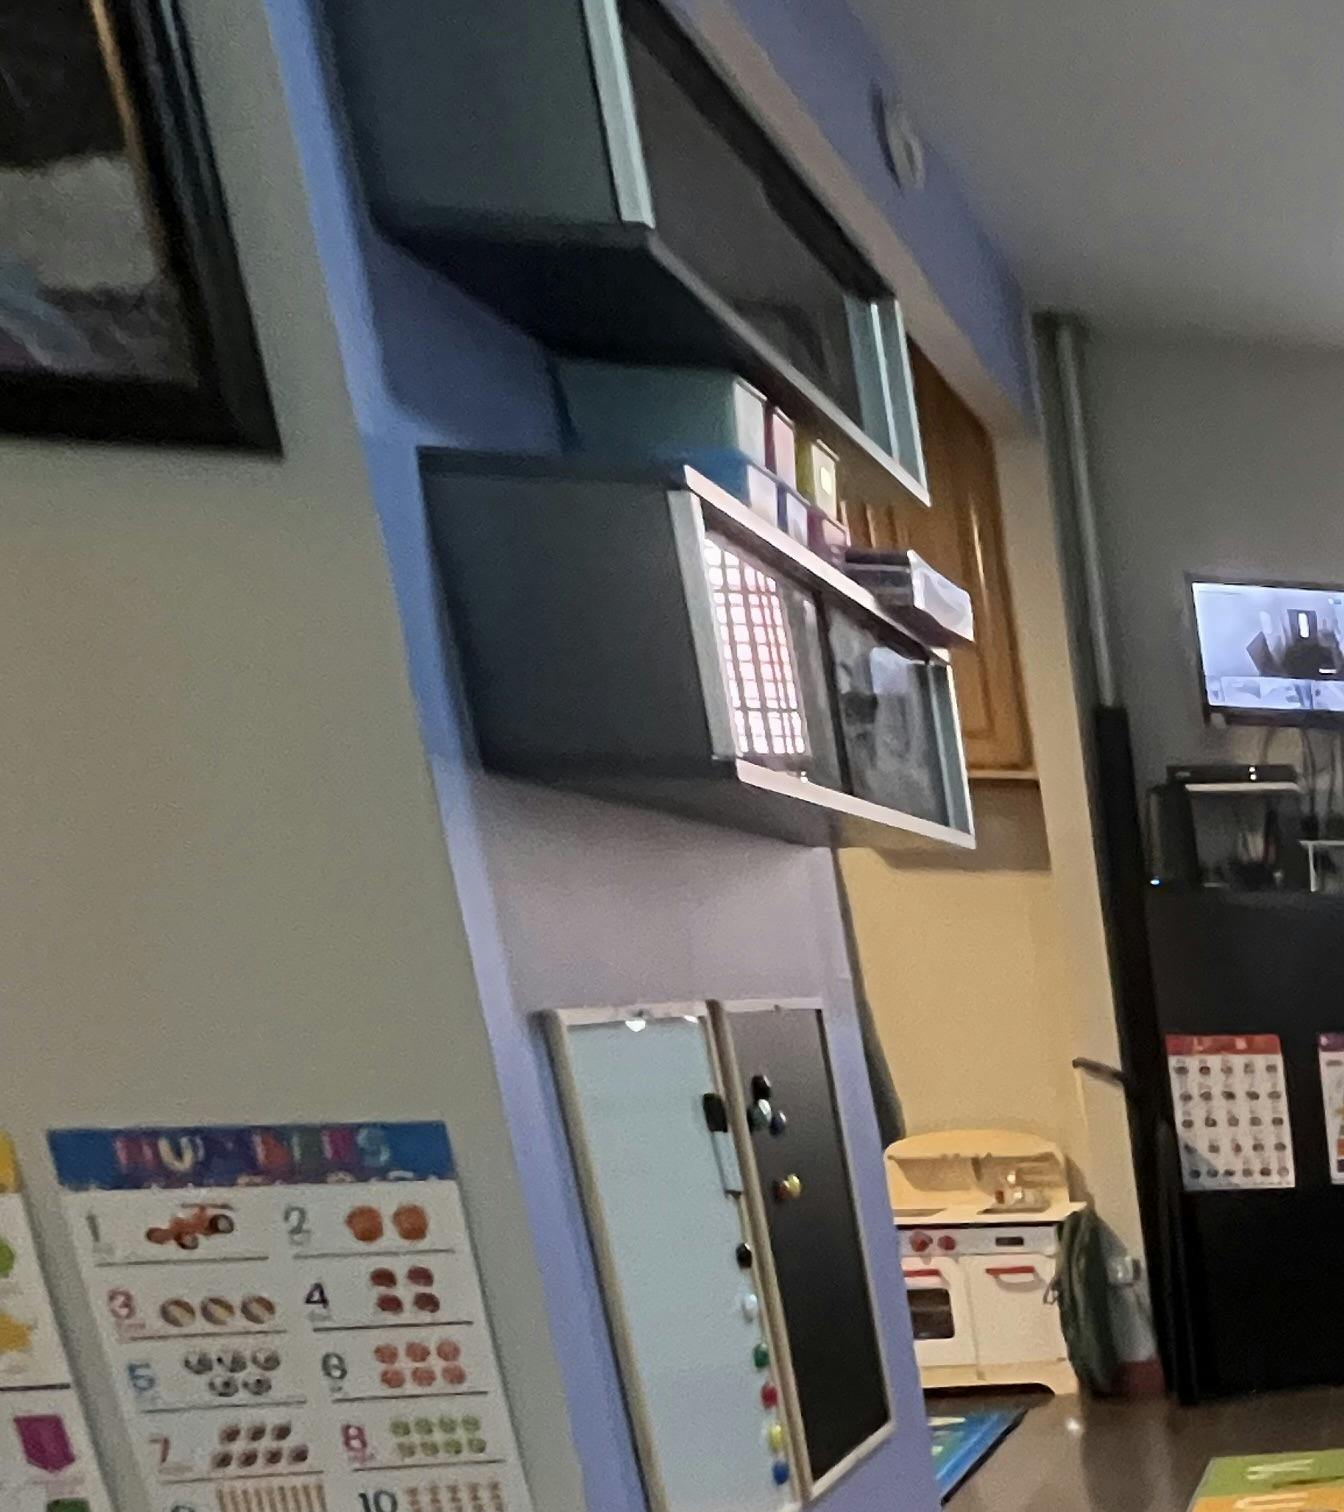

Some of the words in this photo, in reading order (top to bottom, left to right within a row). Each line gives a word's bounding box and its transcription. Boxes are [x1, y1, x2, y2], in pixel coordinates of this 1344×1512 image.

[284, 1206, 309, 1234] 2
[108, 1289, 136, 1320] 3
[305, 1282, 329, 1309] 4
[127, 1362, 156, 1393] 5
[321, 1352, 348, 1380] 6
[149, 1437, 172, 1463] 7
[341, 1424, 368, 1450] 8
